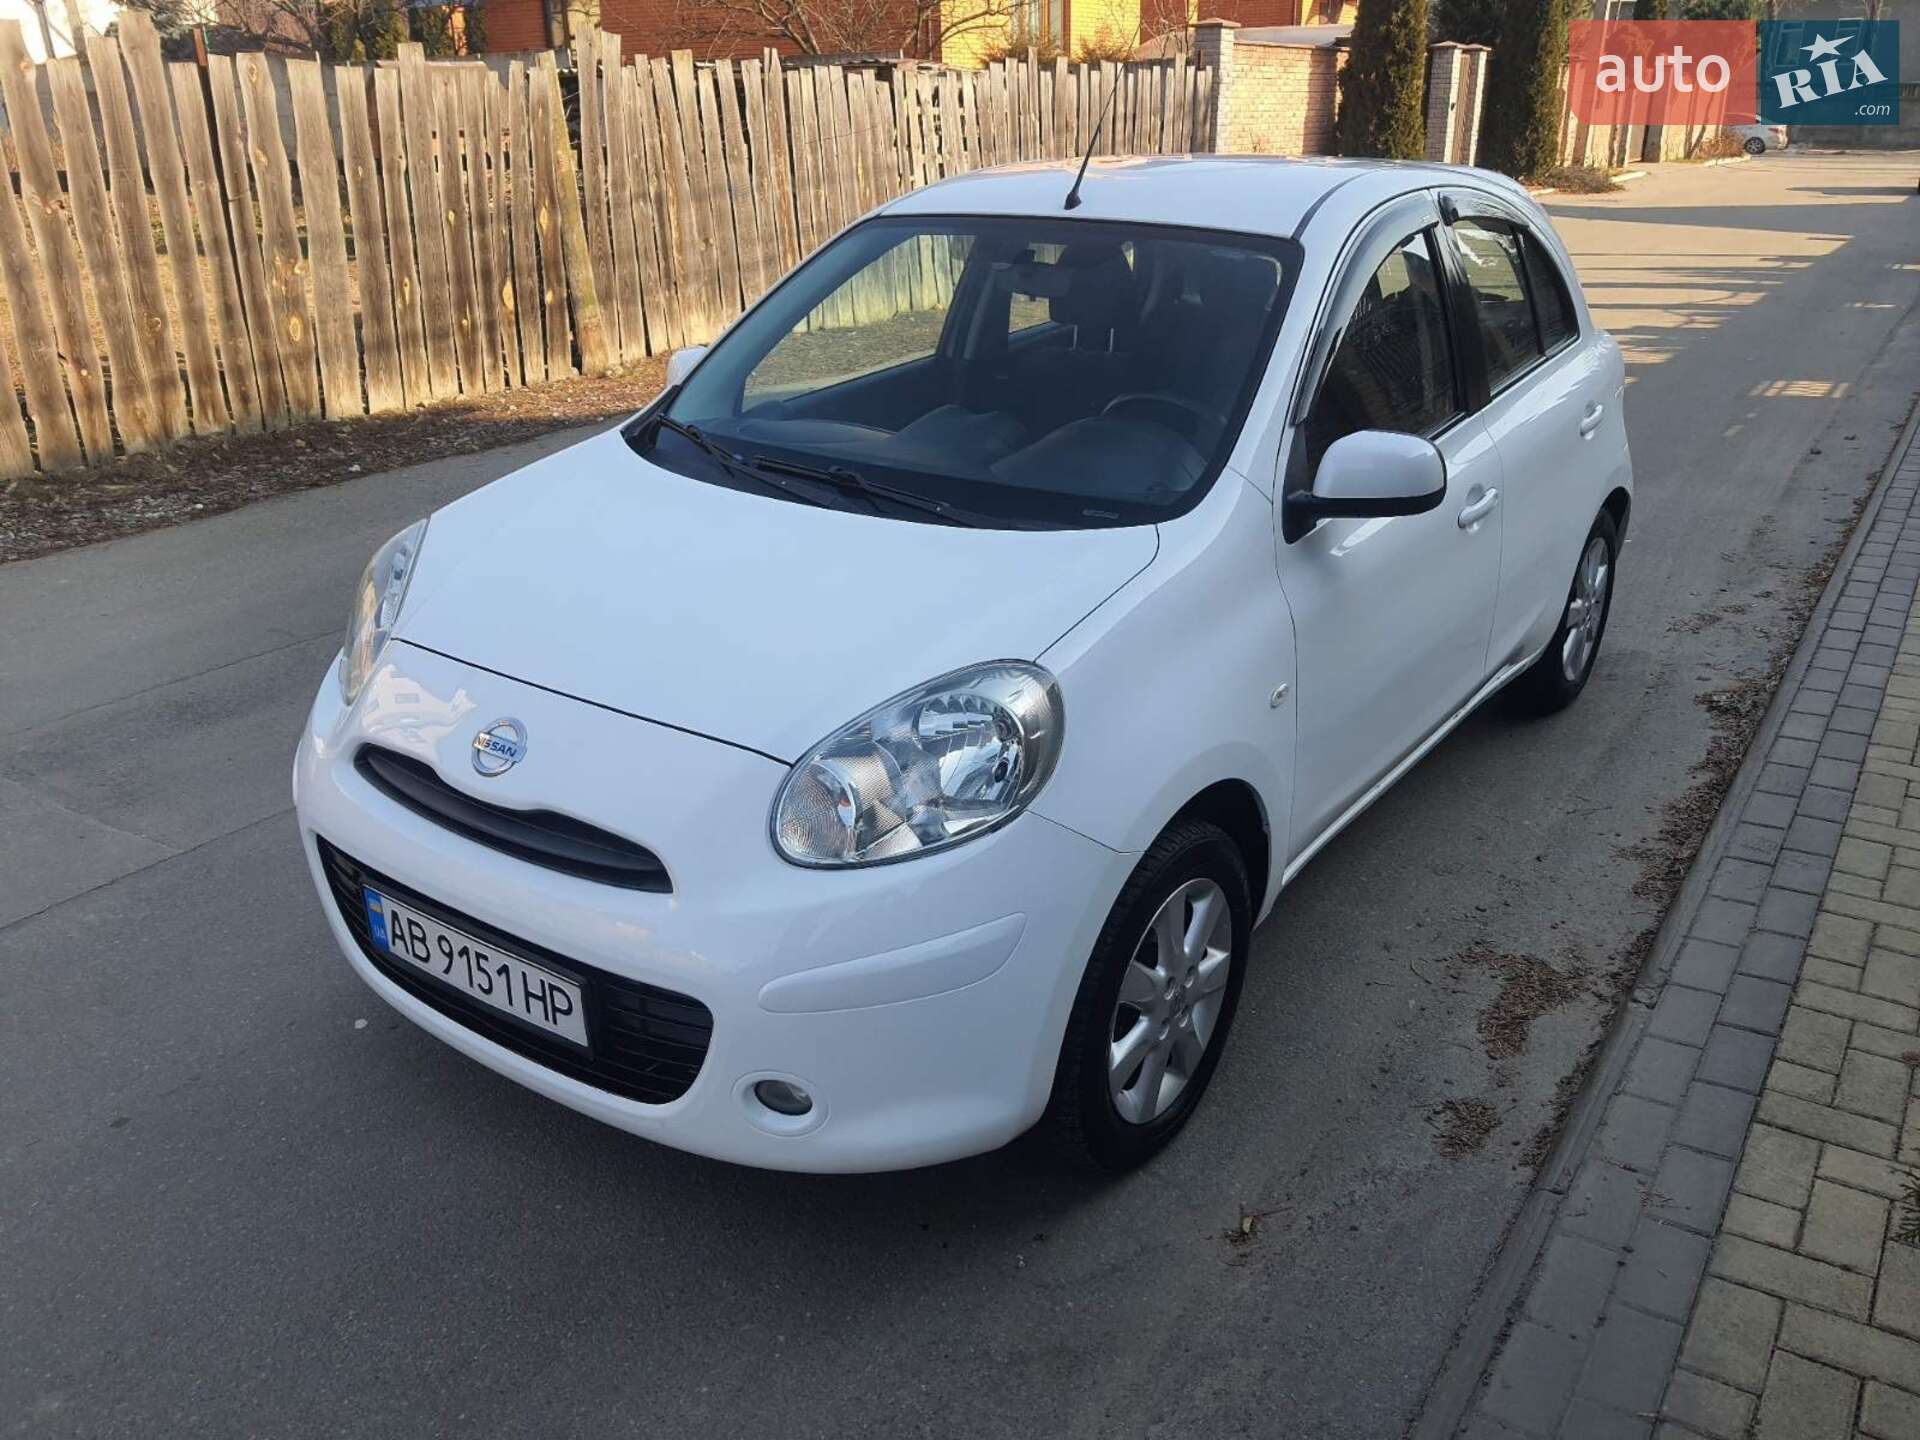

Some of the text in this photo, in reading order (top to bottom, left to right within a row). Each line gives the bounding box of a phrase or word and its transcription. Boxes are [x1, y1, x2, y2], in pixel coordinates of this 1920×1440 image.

[477, 736, 517, 757] NISSAN
[391, 909, 573, 1025] AB 9151 HP
